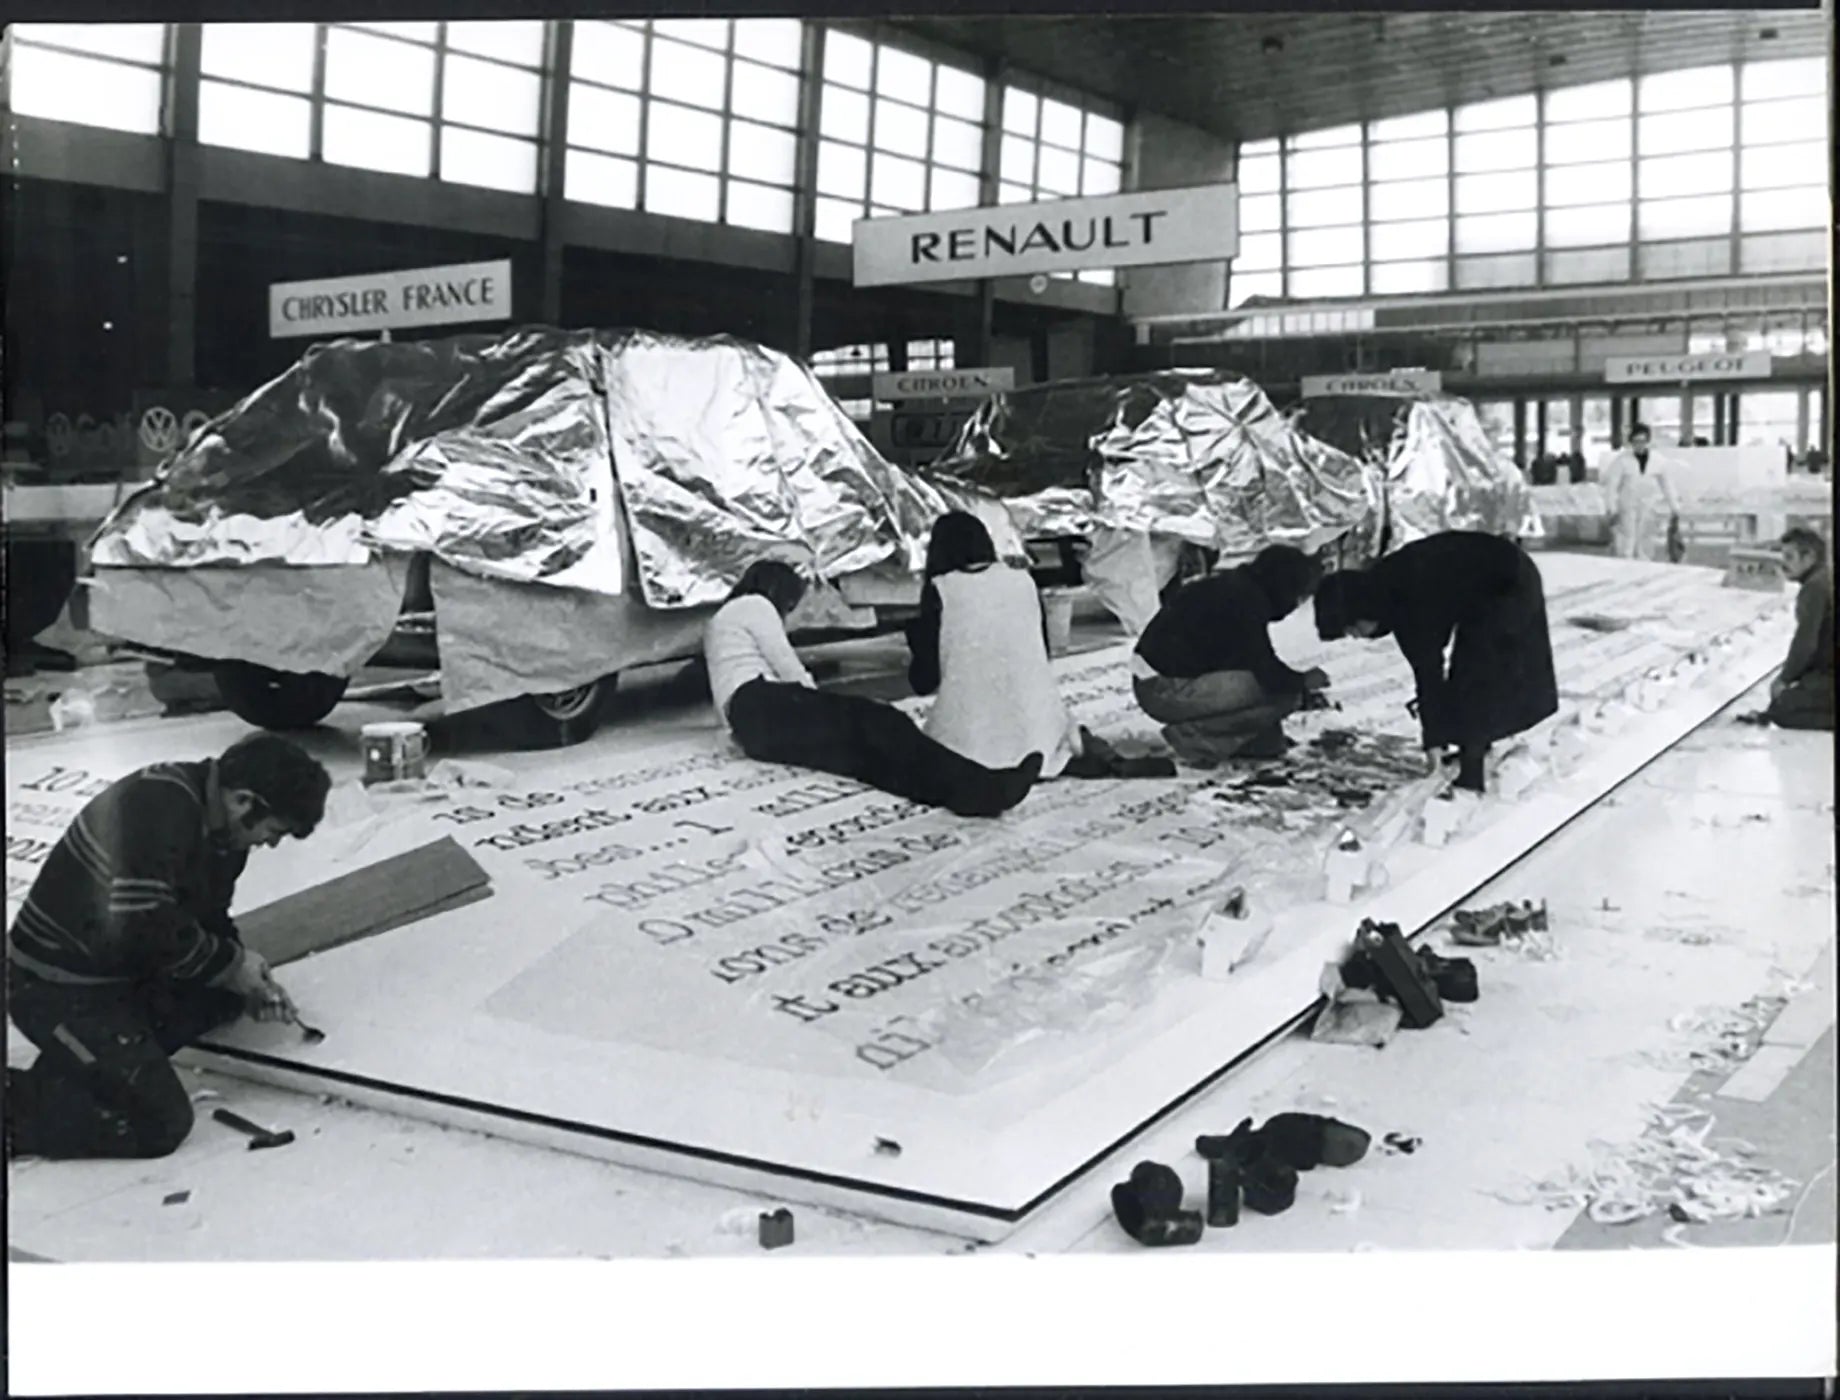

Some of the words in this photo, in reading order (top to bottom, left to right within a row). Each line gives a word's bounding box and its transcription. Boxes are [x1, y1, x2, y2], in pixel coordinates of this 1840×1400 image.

[911, 210, 1167, 265] RENAULT
[281, 287, 389, 323] CHRYSLER
[403, 276, 494, 314] FRANCE
[1626, 359, 1746, 376] PEUGEOT
[18, 766, 90, 791] 10
